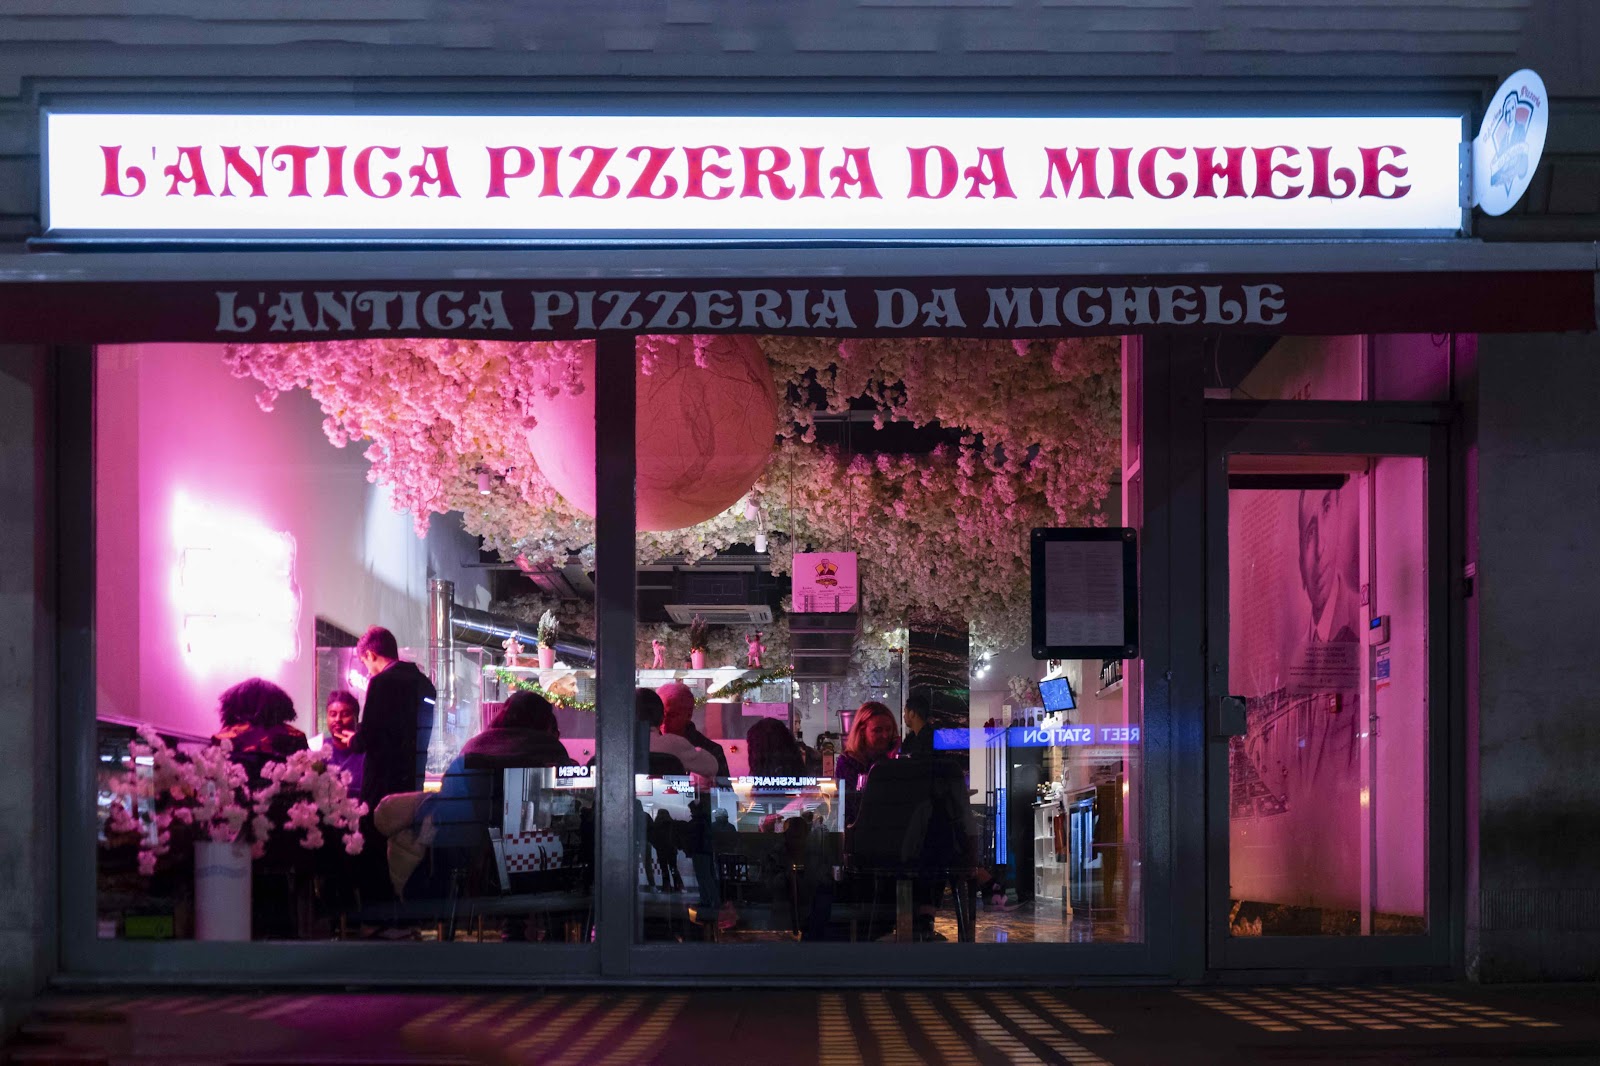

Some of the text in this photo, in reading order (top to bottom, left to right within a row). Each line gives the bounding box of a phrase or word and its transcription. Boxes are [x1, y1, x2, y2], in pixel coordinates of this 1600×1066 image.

[99, 144, 1412, 200] L'ANTICA PIZZERIA DA MICHELE
[214, 283, 1288, 333] L'ANTICA PIZZERIA DA MICHELE
